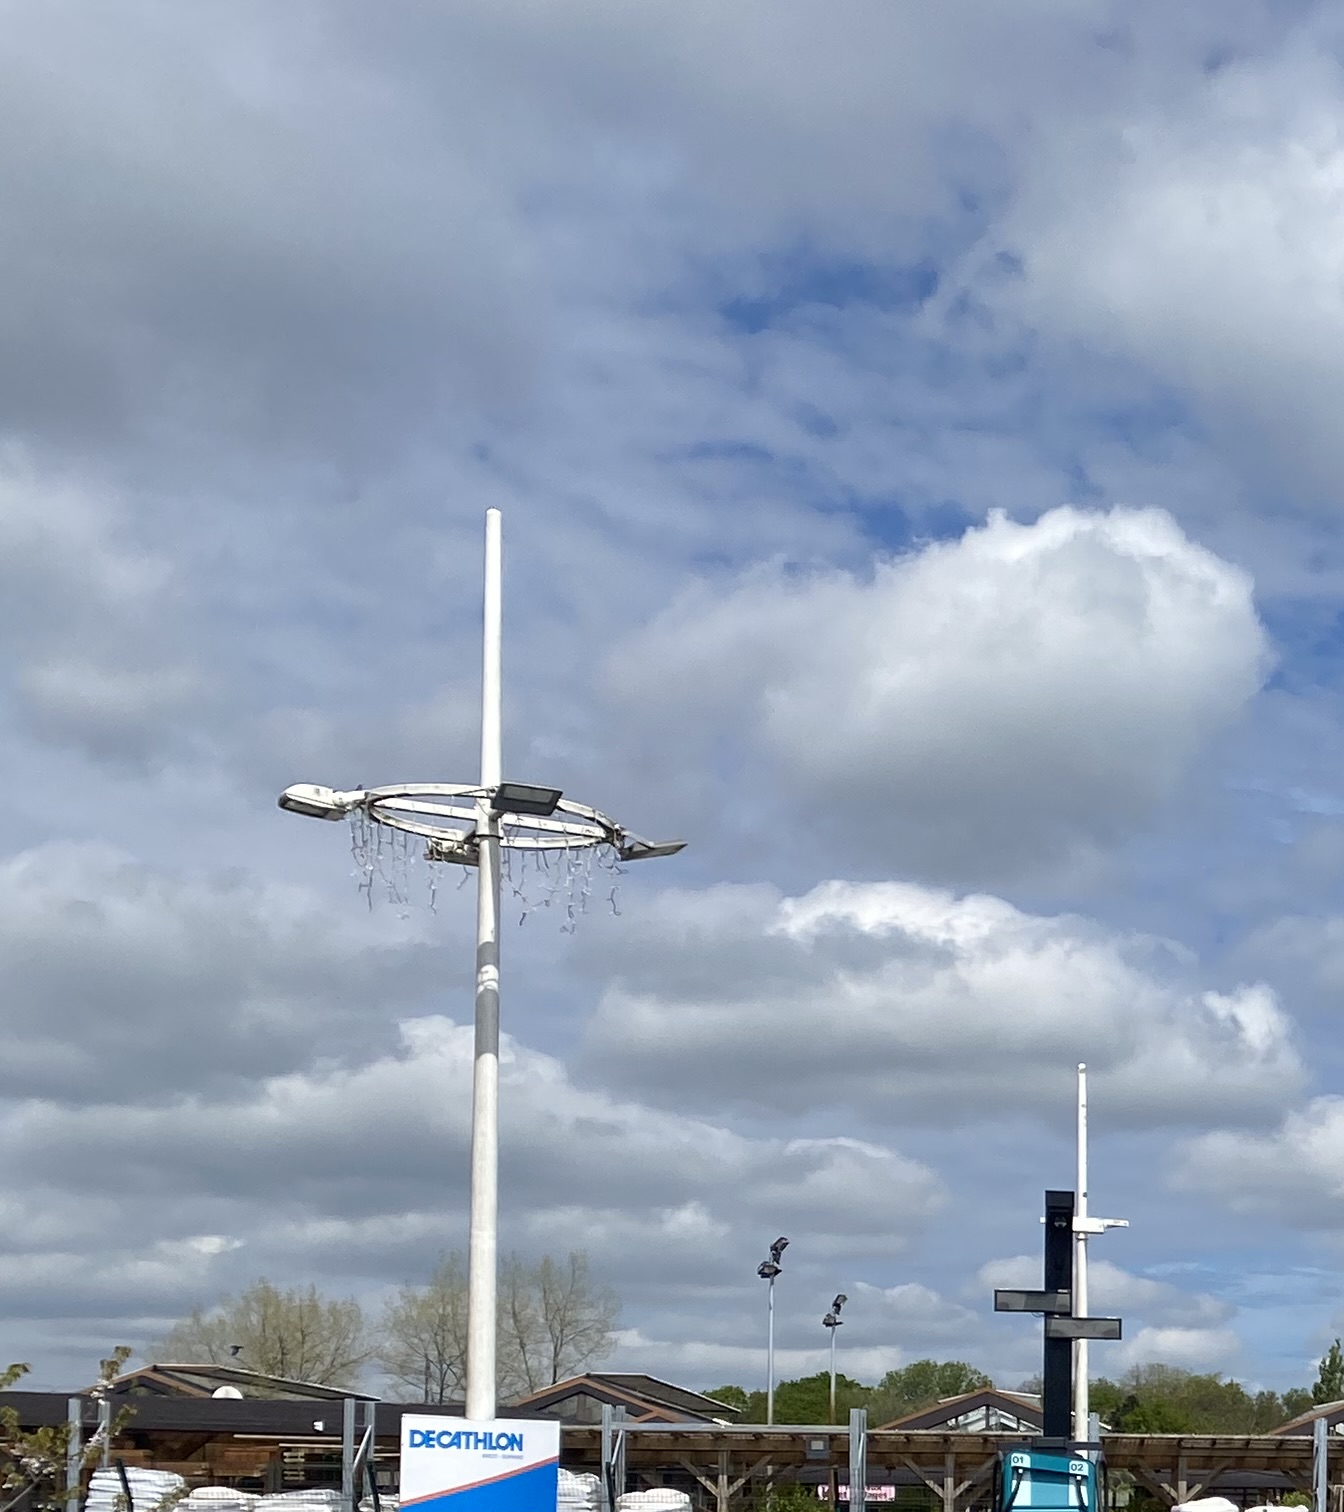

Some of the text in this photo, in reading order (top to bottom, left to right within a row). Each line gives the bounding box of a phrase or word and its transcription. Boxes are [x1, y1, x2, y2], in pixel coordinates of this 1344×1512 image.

[409, 1429, 523, 1451] DECATHLON
[1012, 1455, 1024, 1464] 01
[1070, 1463, 1084, 1472] 02
